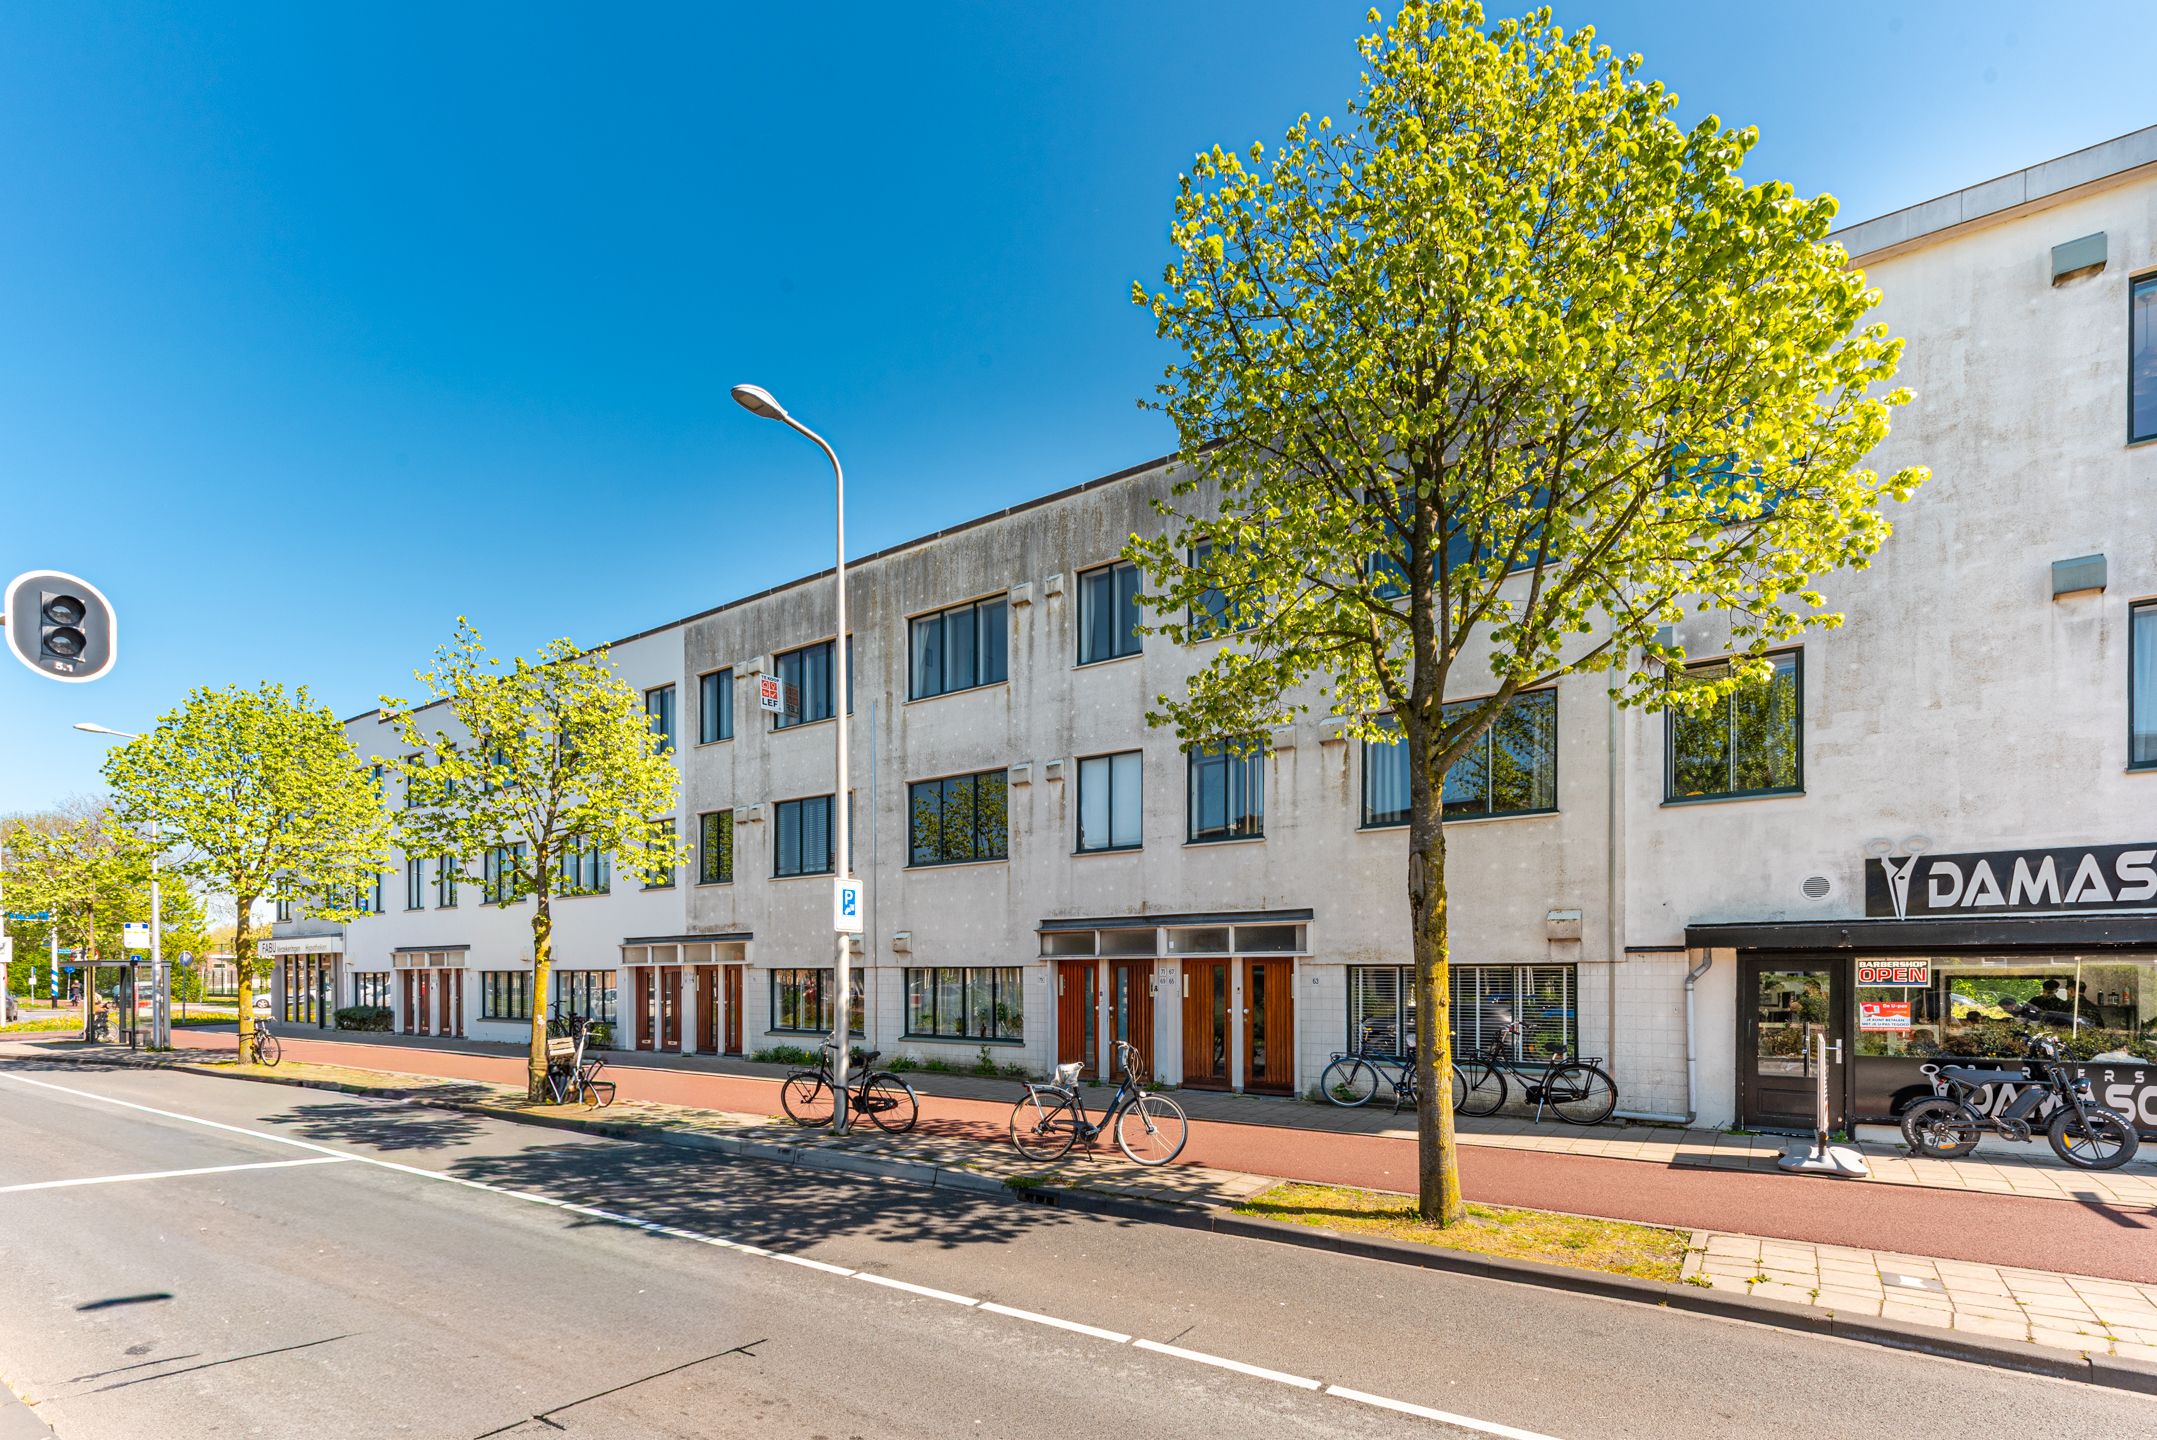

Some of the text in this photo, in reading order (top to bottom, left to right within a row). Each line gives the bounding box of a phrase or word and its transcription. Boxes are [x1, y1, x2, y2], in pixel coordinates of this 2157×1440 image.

[762, 697, 778, 707] LEF
[1928, 849, 2157, 908] DAMAS
[262, 942, 276, 954] FABU
[1858, 967, 1927, 982] OPEN
